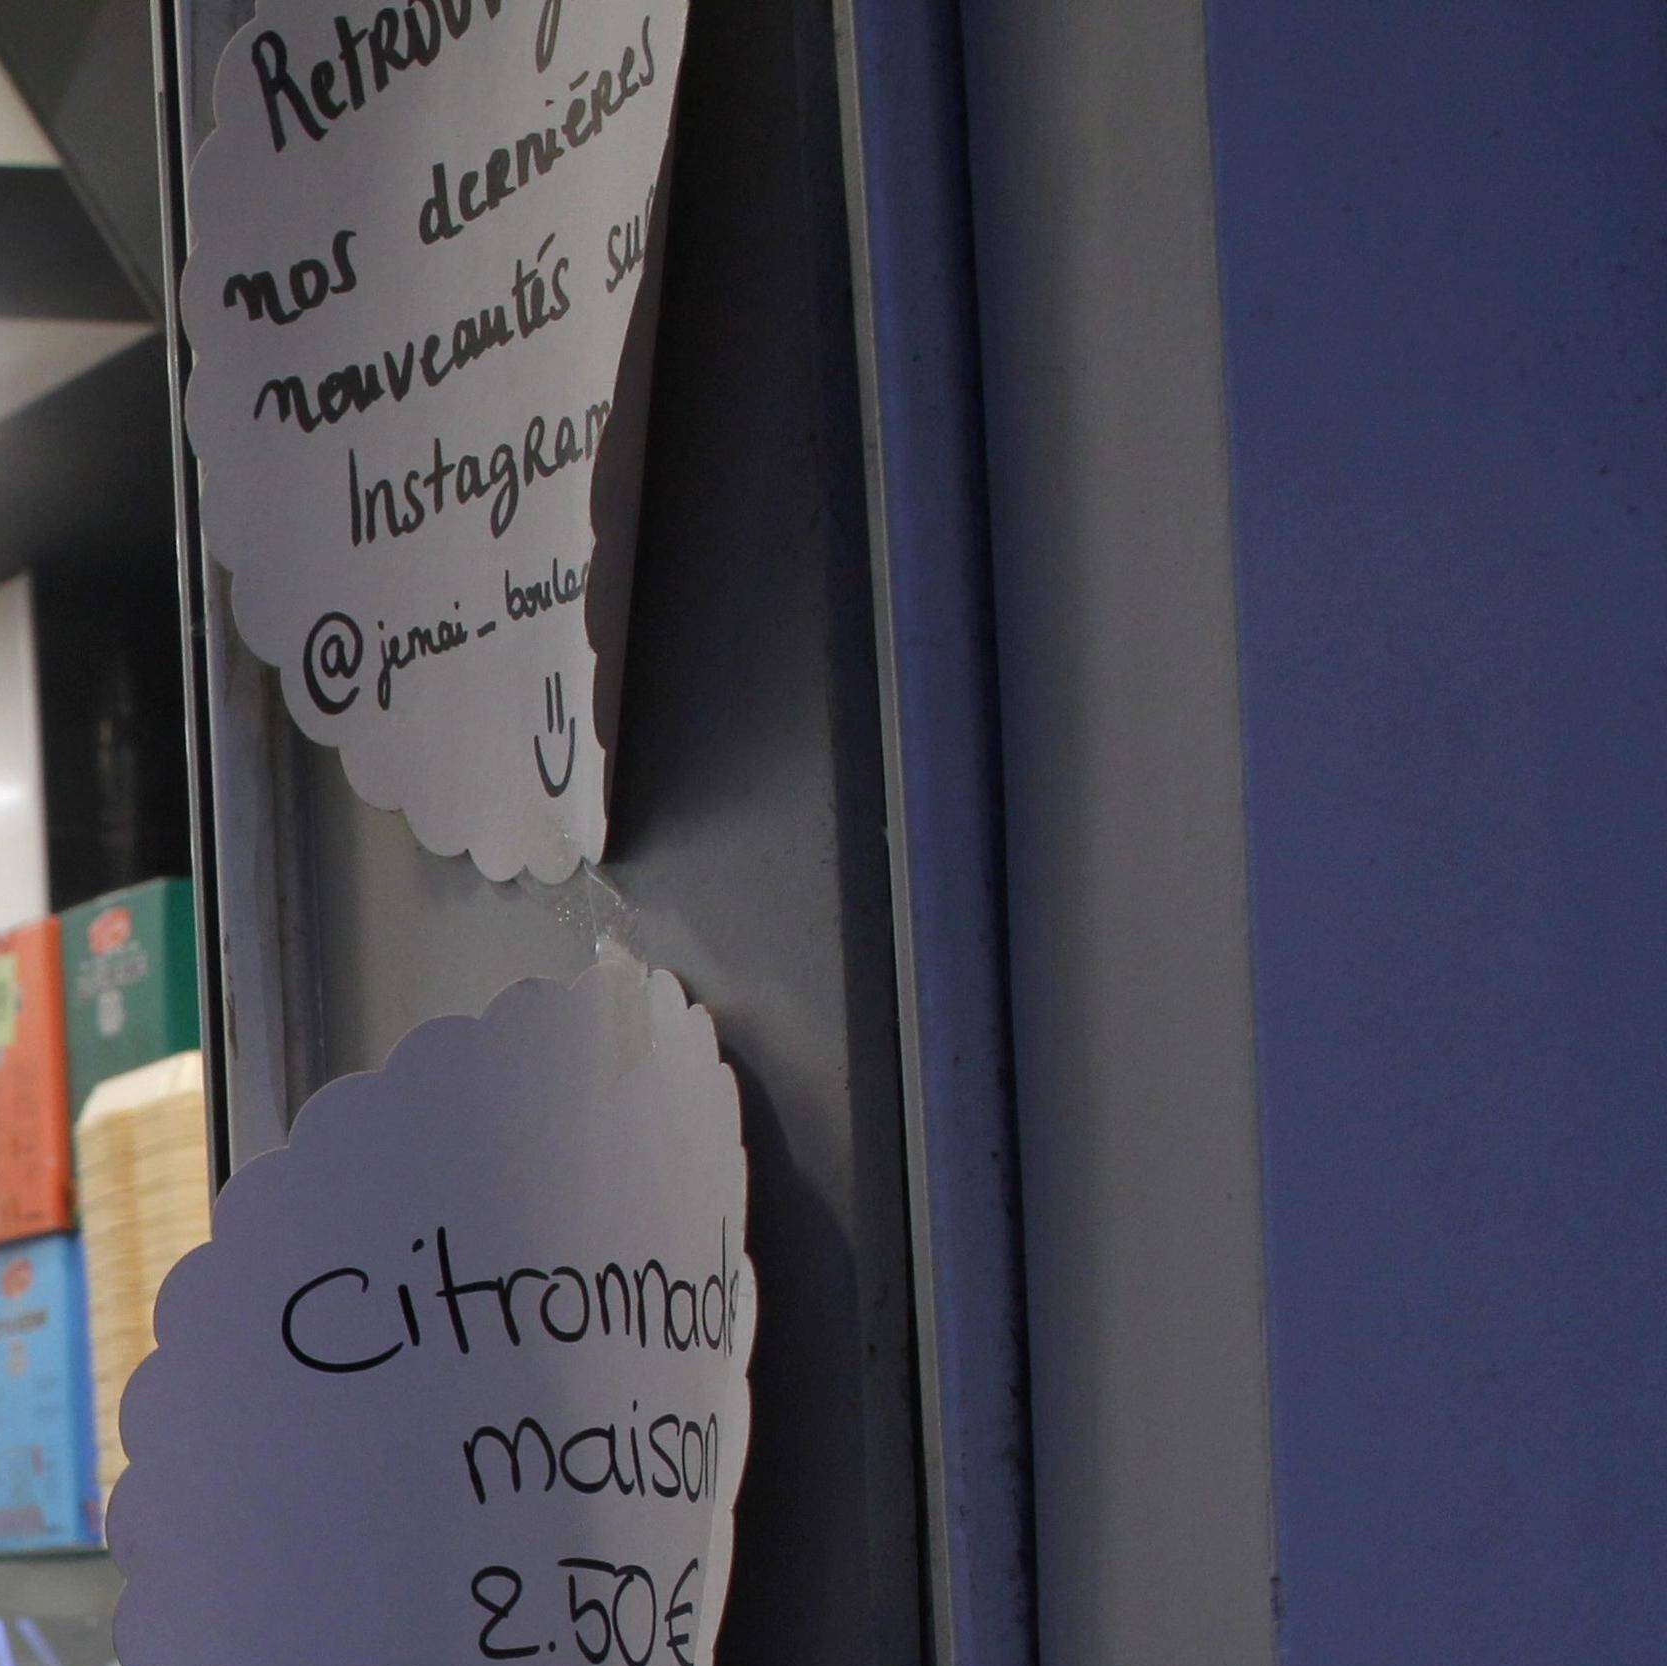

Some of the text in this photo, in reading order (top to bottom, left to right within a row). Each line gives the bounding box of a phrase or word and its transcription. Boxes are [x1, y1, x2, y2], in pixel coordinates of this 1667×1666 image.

[223, 230, 357, 327] nos
[253, 233, 570, 433] nouveautés
[348, 400, 611, 547] Instagram
[463, 1399, 718, 1504] maison
